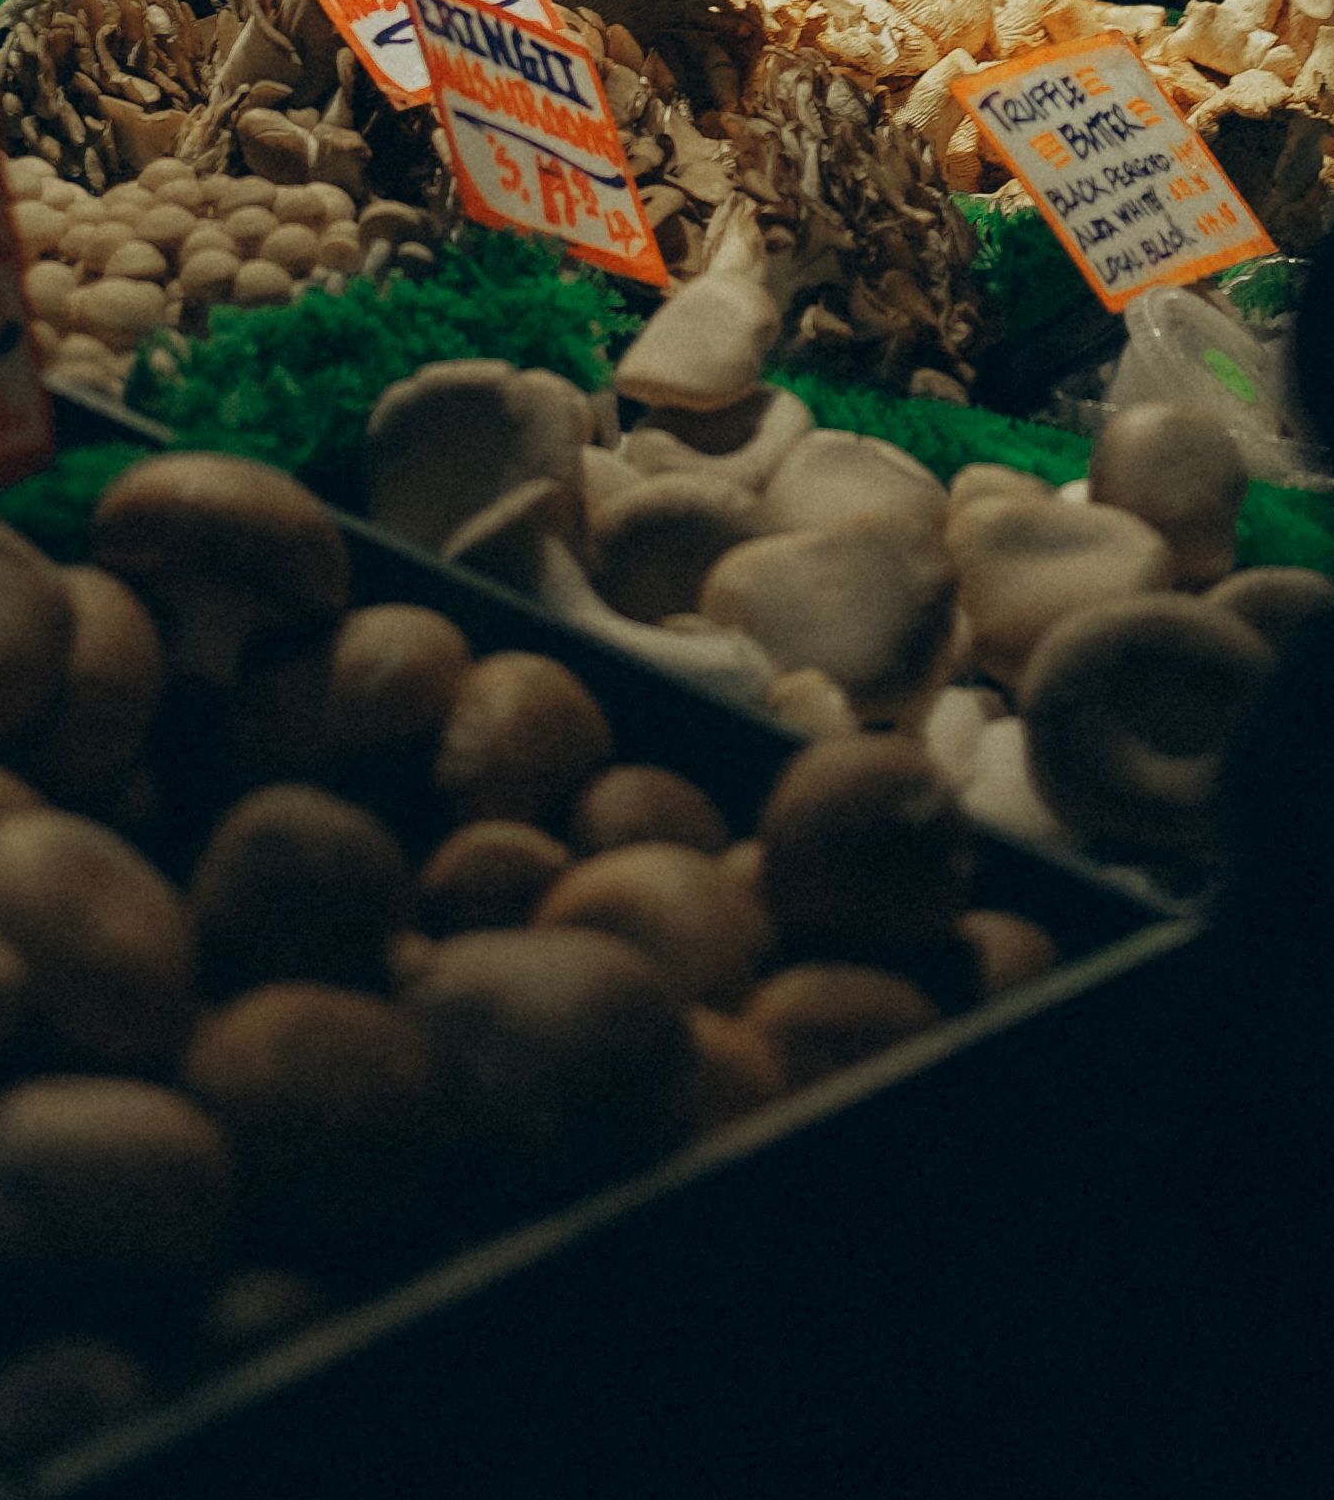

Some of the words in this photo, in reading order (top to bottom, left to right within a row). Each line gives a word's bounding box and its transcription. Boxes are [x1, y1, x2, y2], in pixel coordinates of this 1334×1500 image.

[979, 75, 1085, 133] TRUFFLE
[1057, 103, 1146, 161] BUTTER
[1044, 175, 1112, 220] BLACK
